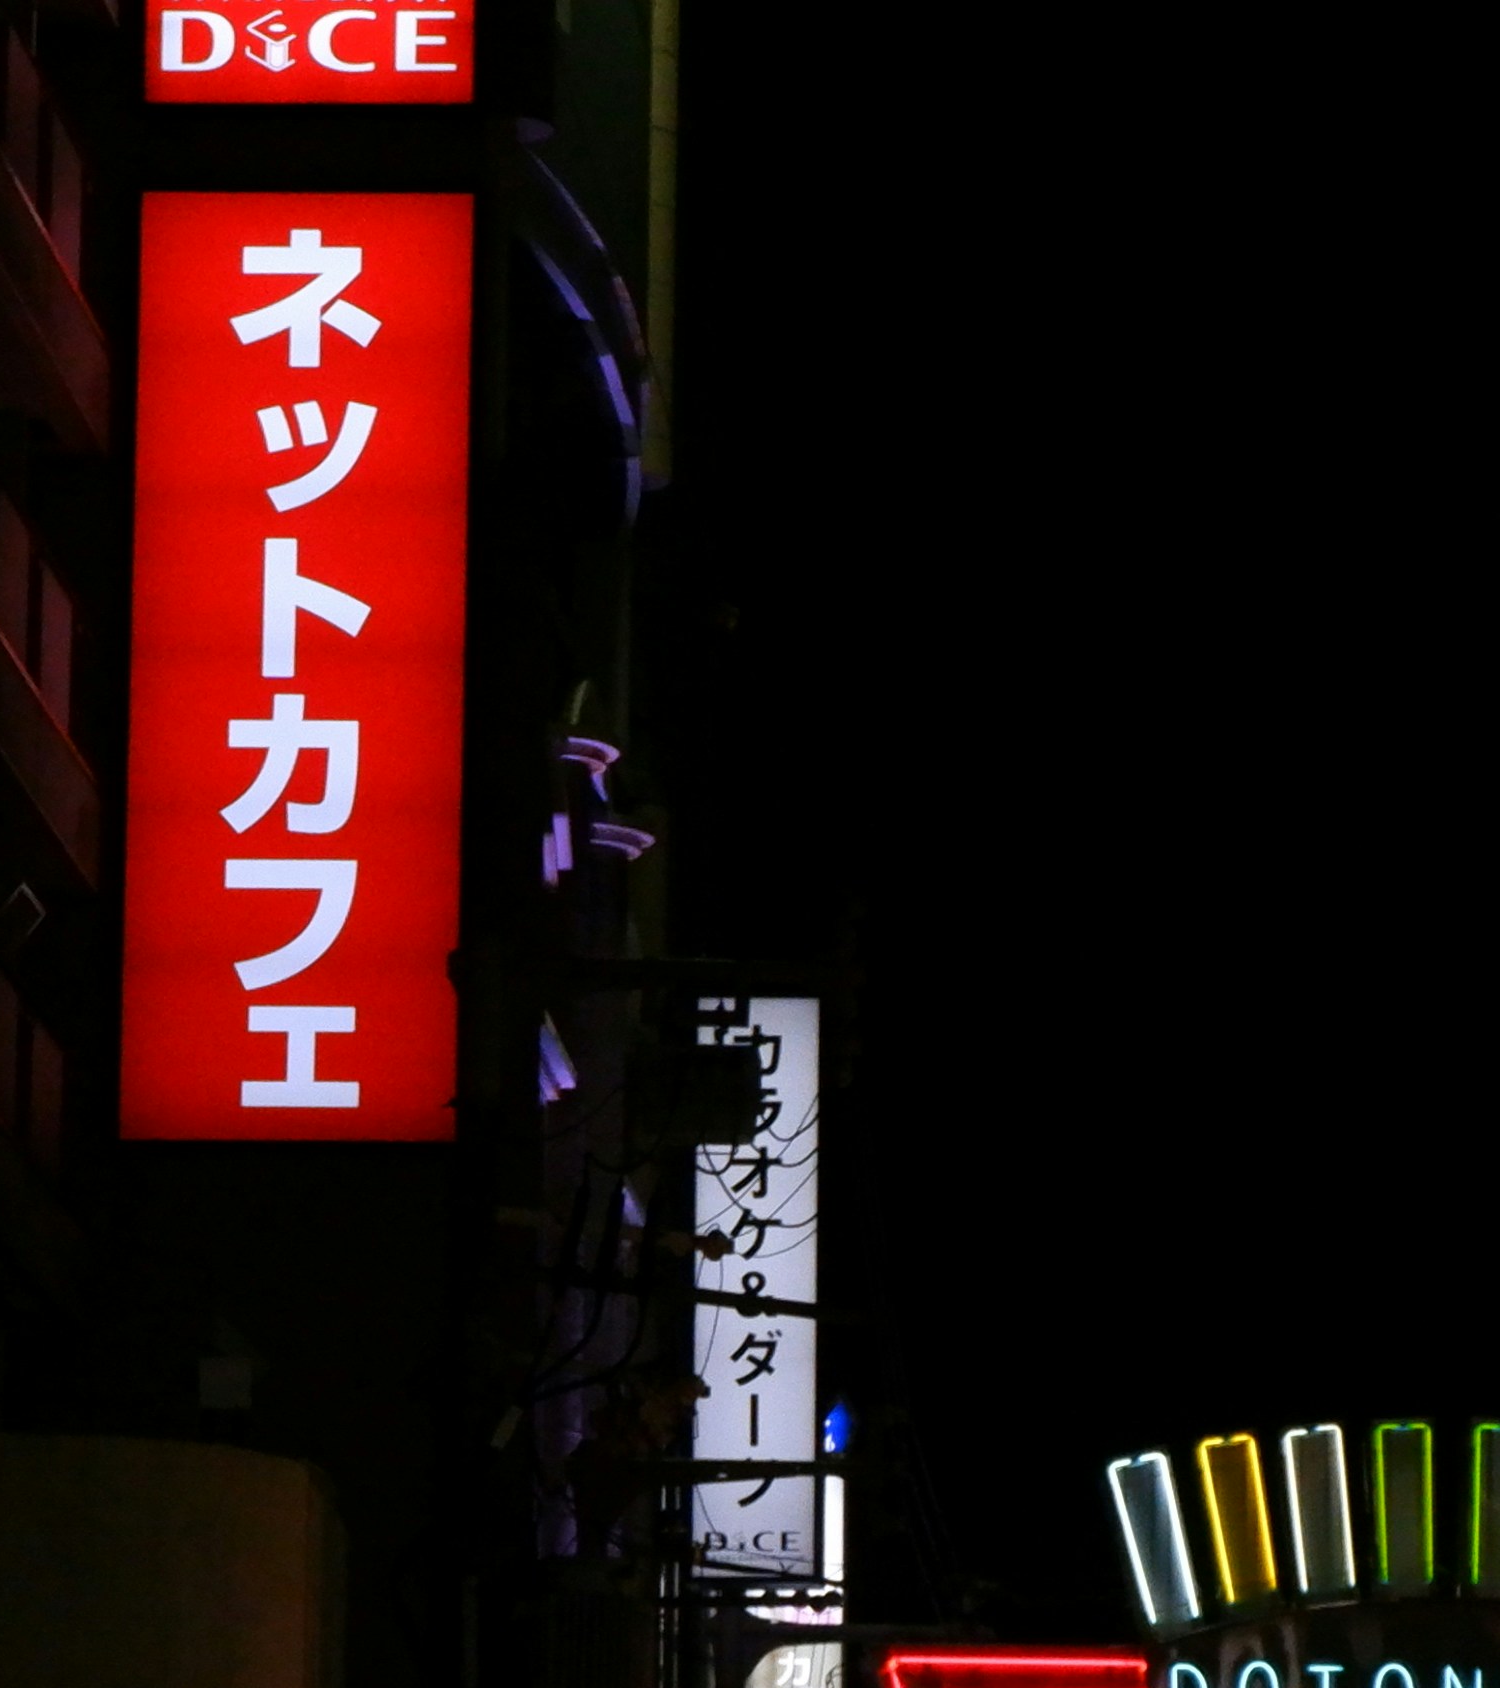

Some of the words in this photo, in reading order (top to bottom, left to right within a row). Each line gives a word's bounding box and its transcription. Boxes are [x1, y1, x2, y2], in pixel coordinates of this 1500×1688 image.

[219, 228, 382, 1109] ネットカフェ
